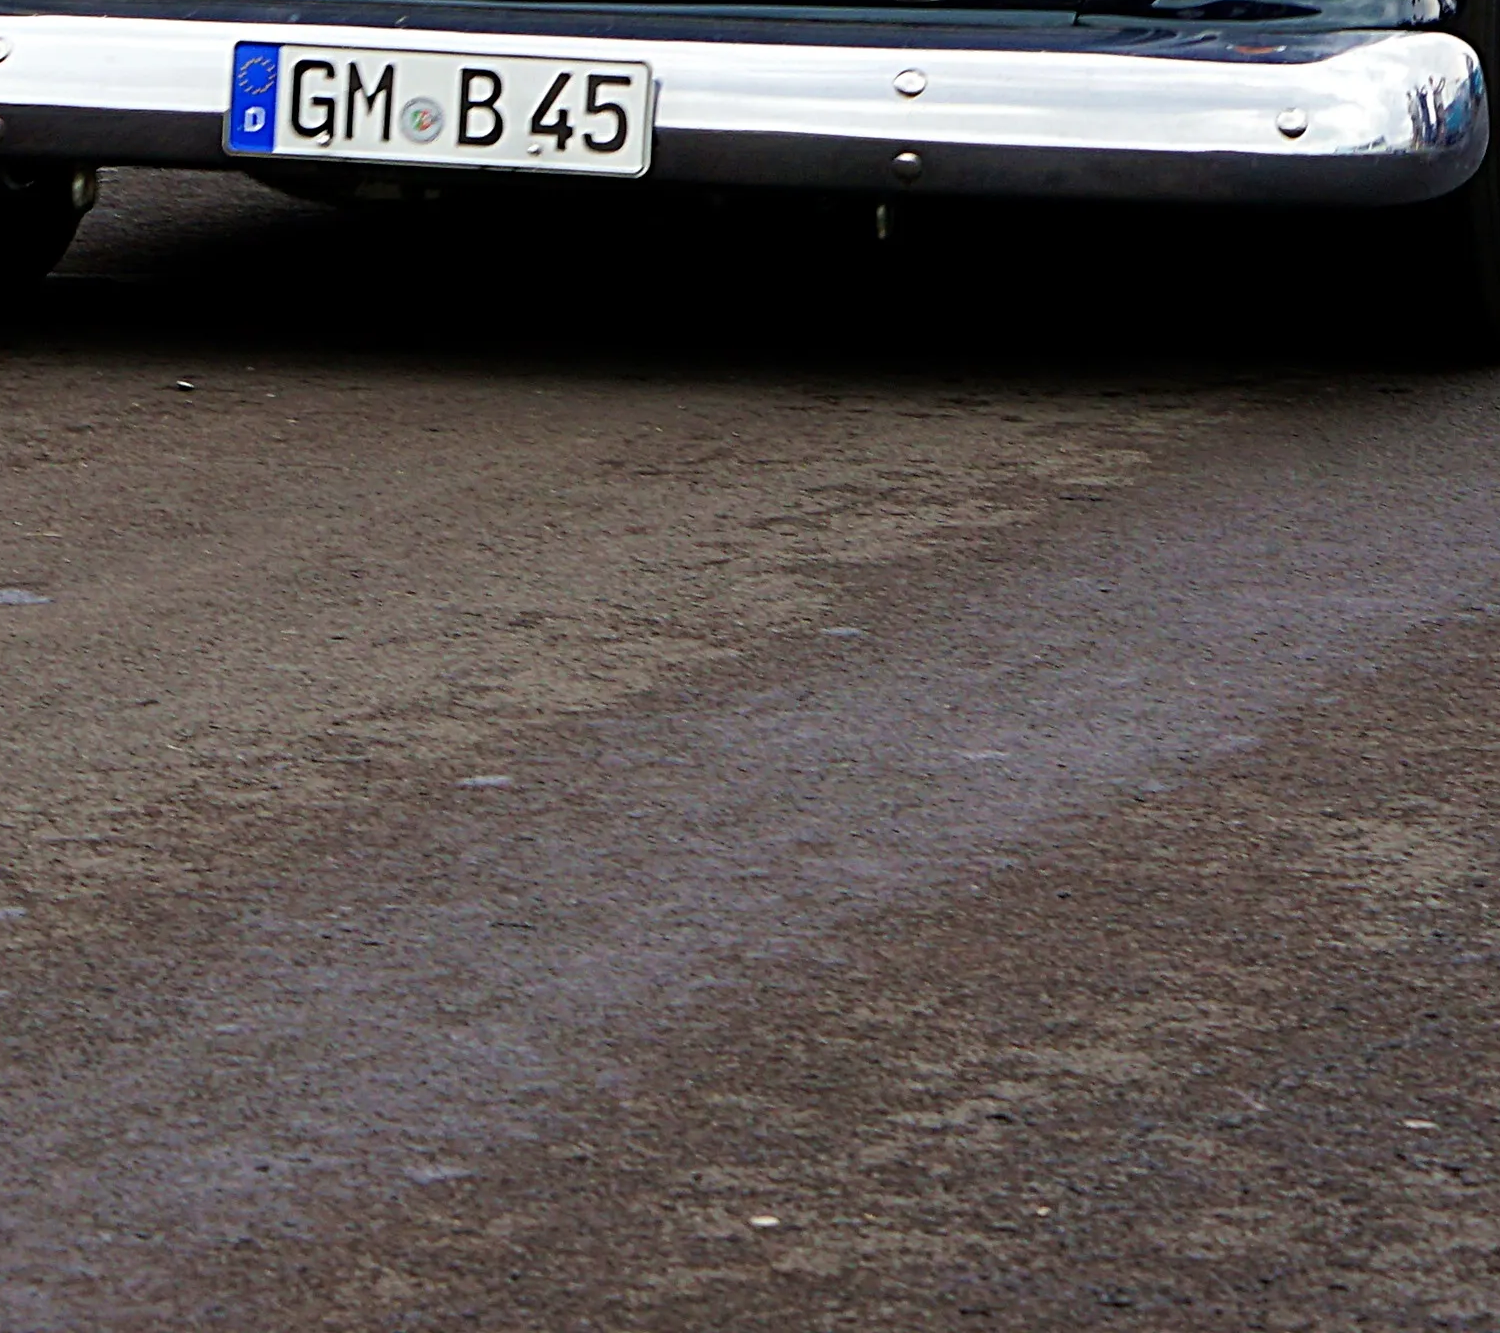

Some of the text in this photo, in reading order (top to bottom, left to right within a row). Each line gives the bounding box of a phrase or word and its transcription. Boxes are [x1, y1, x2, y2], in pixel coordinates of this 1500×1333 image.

[244, 106, 266, 133] D
[291, 58, 631, 154] GM B 45
